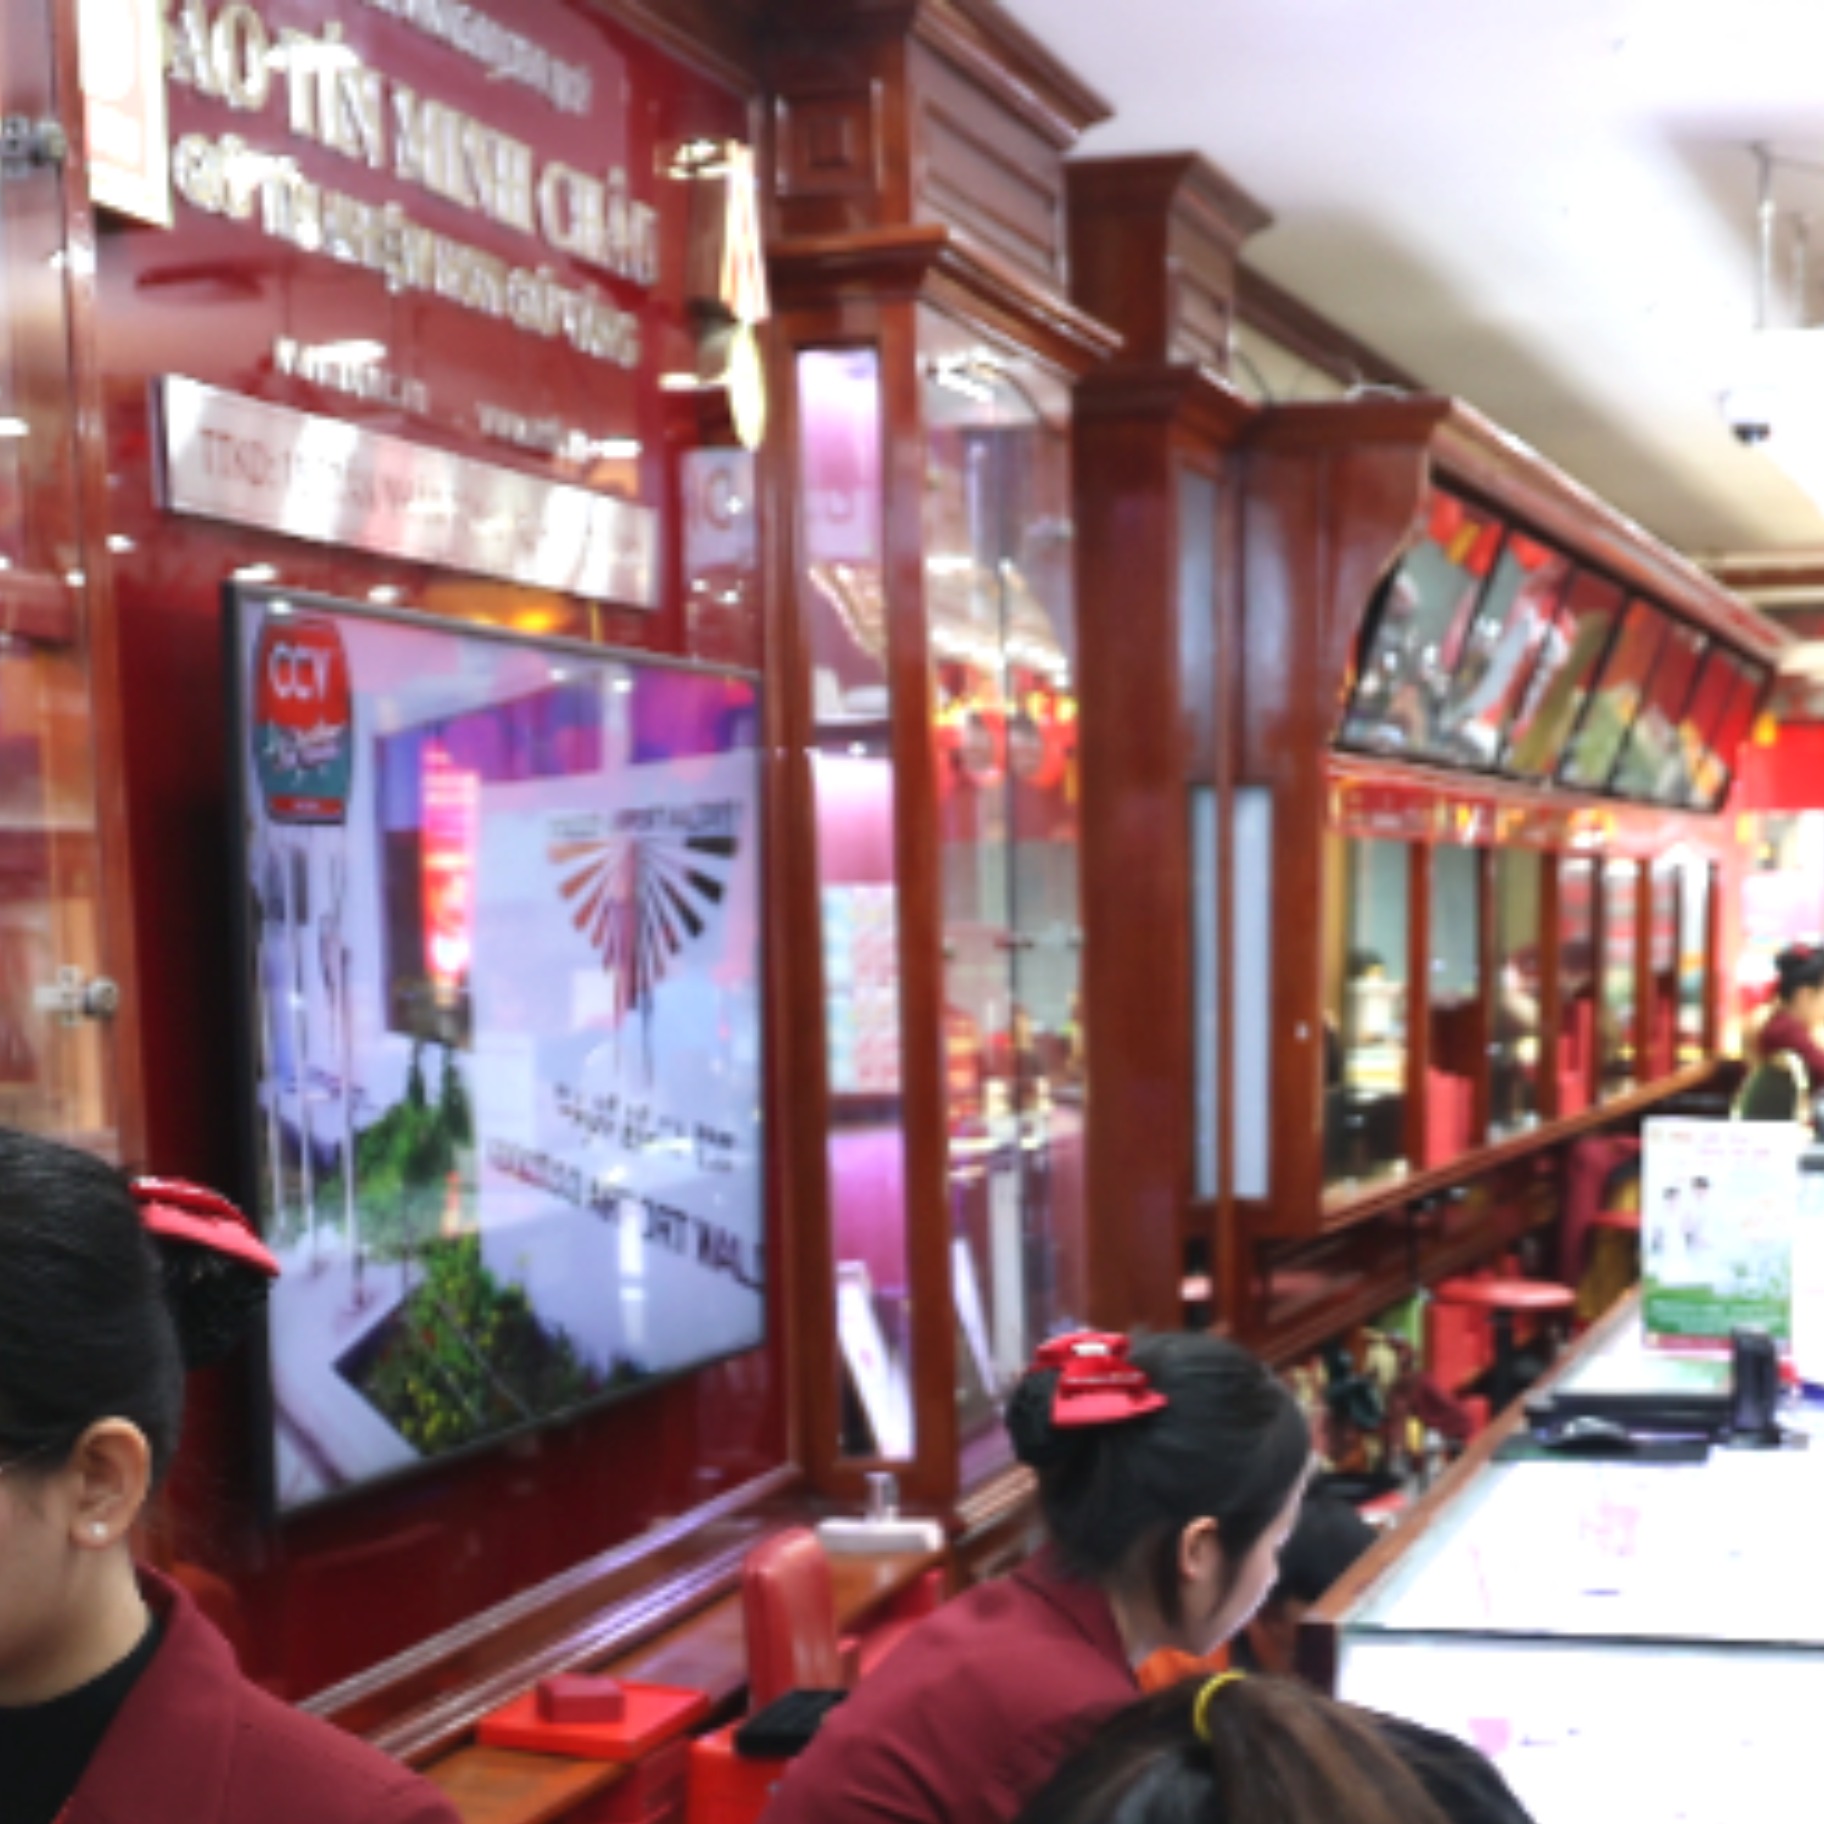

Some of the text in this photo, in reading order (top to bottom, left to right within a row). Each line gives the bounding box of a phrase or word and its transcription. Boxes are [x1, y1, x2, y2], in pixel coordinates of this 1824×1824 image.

[277, 21, 385, 169] TÍN
[392, 78, 535, 237] MINH
[539, 162, 660, 287] CHÂU
